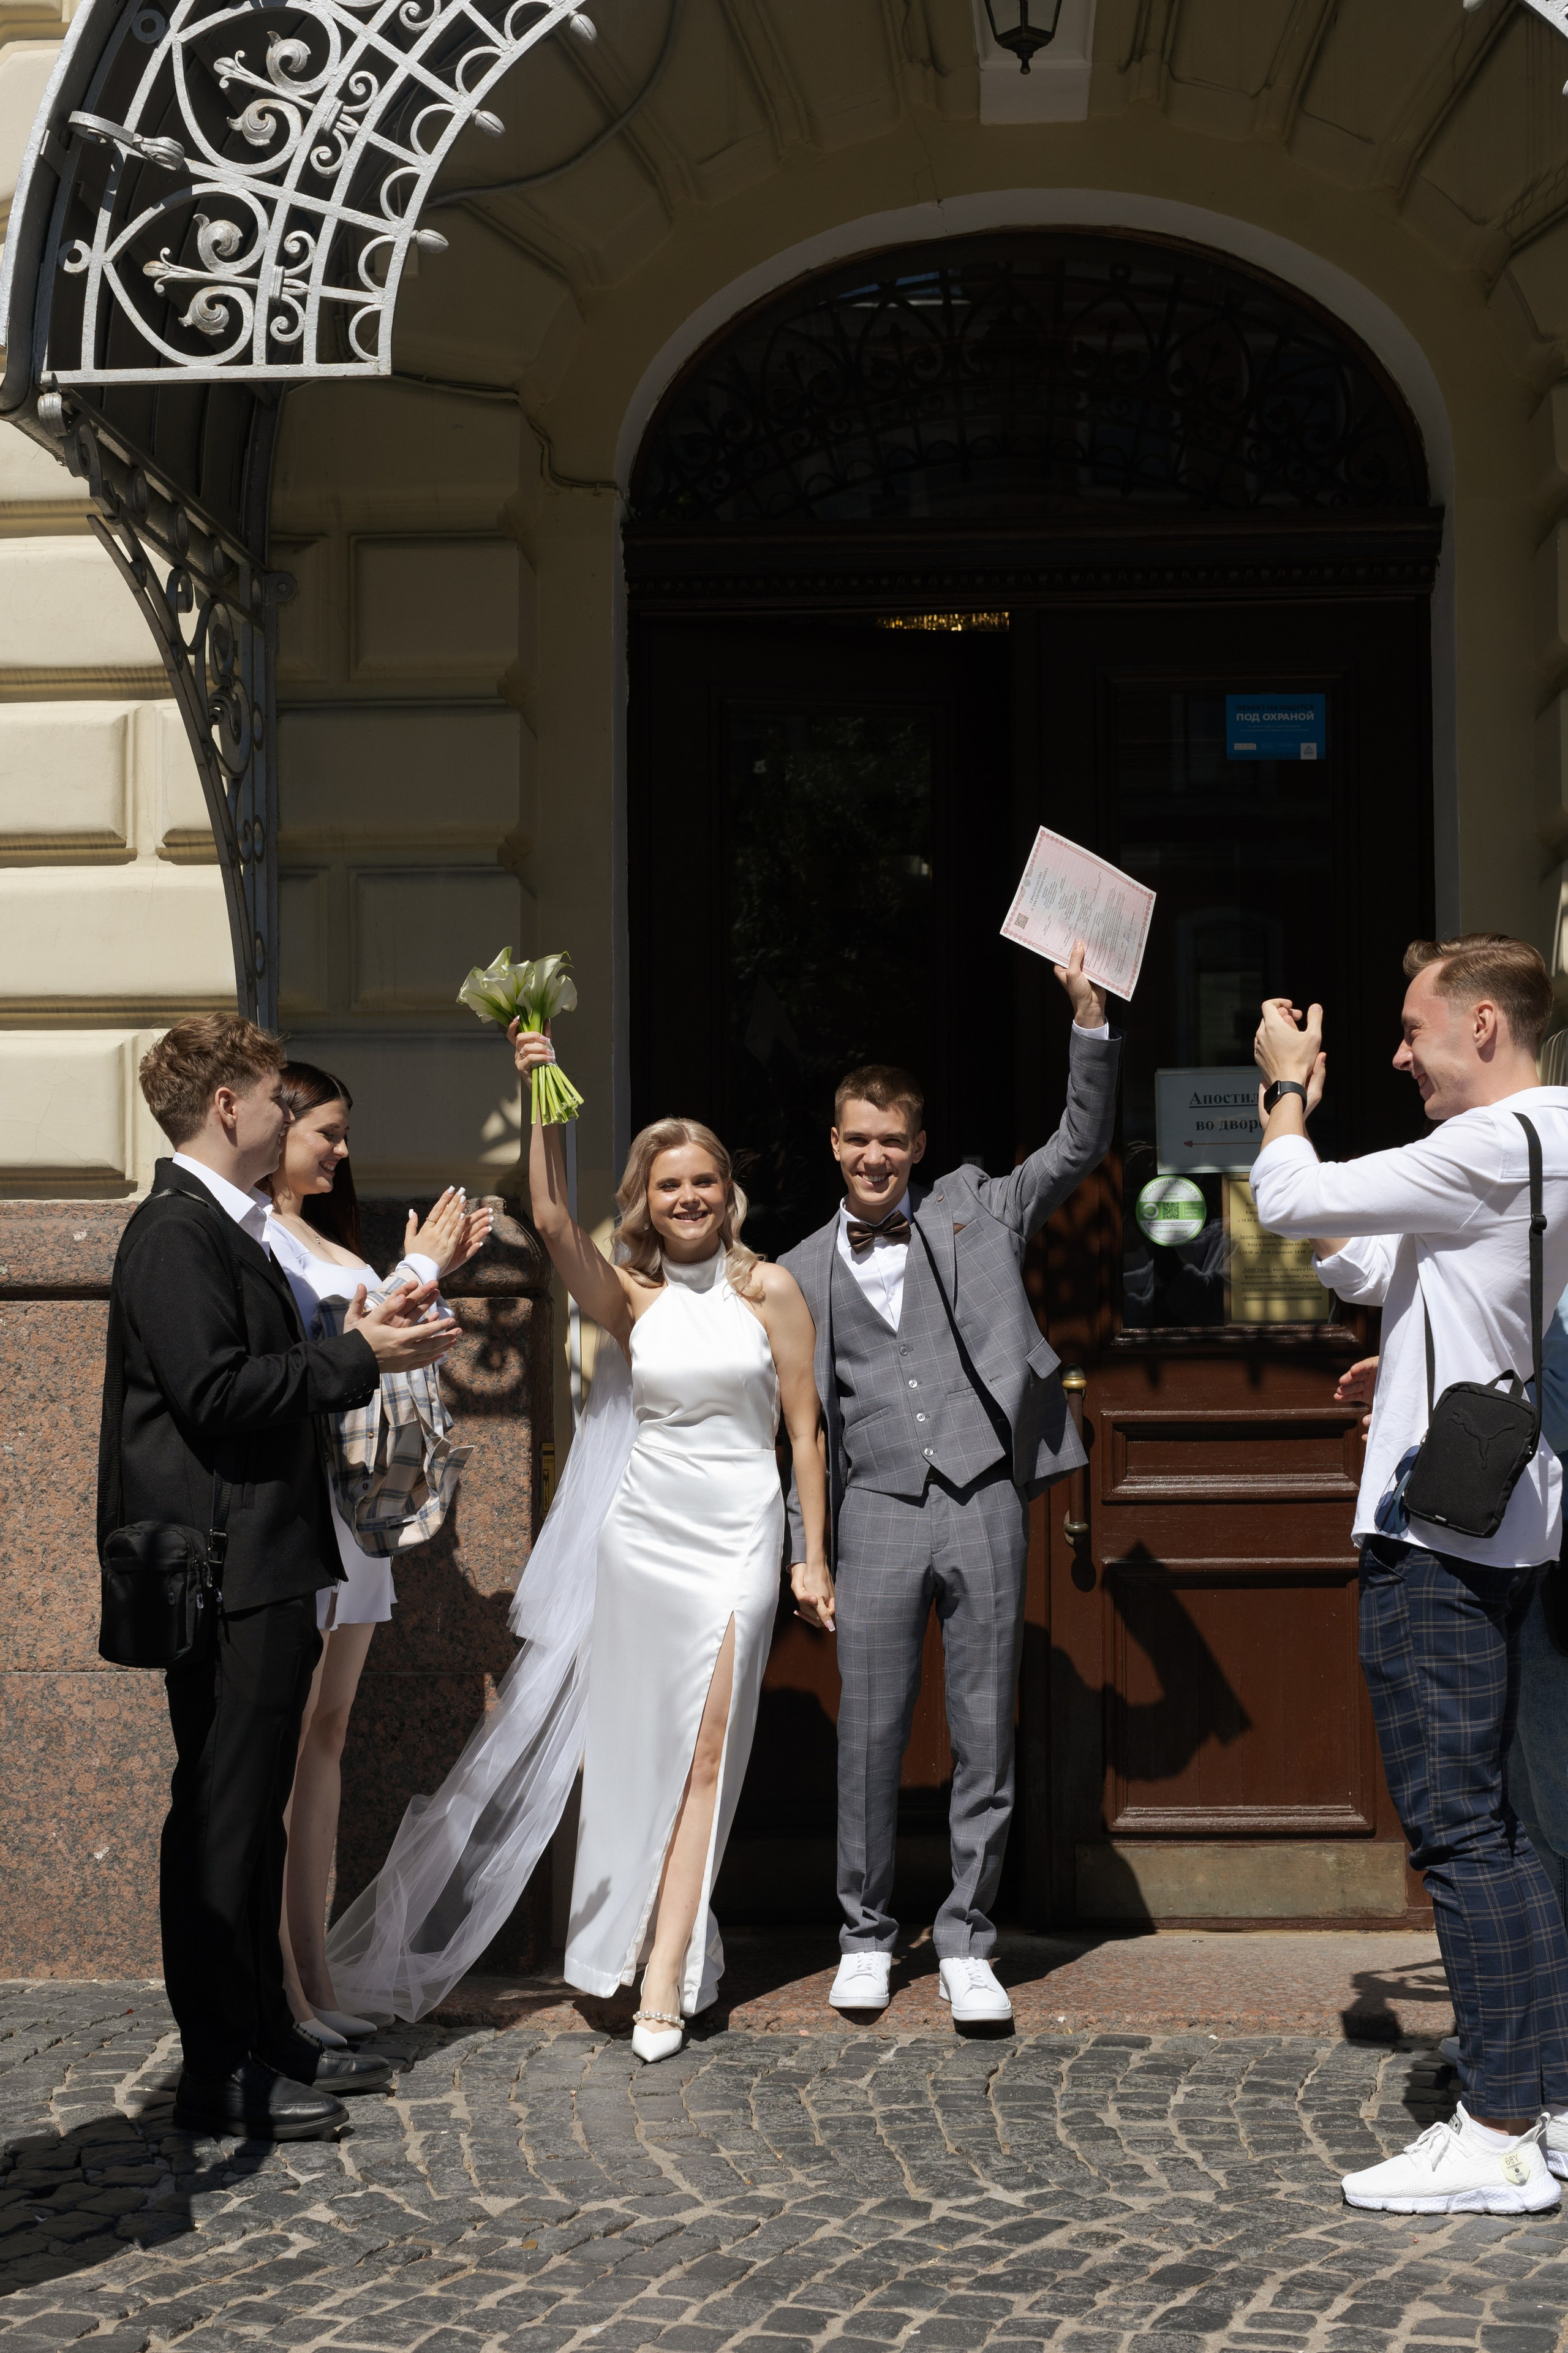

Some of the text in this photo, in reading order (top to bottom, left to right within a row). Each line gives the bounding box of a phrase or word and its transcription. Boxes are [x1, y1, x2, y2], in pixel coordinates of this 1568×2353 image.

[1236, 711, 1314, 723] ПОД ОХРАНОЙ
[1029, 871, 1043, 904] СВИДЕТЕЛЬСТВО
[1189, 1092, 1259, 1105] Апостил
[1196, 1119, 1262, 1133] во двор
[1143, 1179, 1199, 1200] УЧАСТНИК ПРОЕКТА
